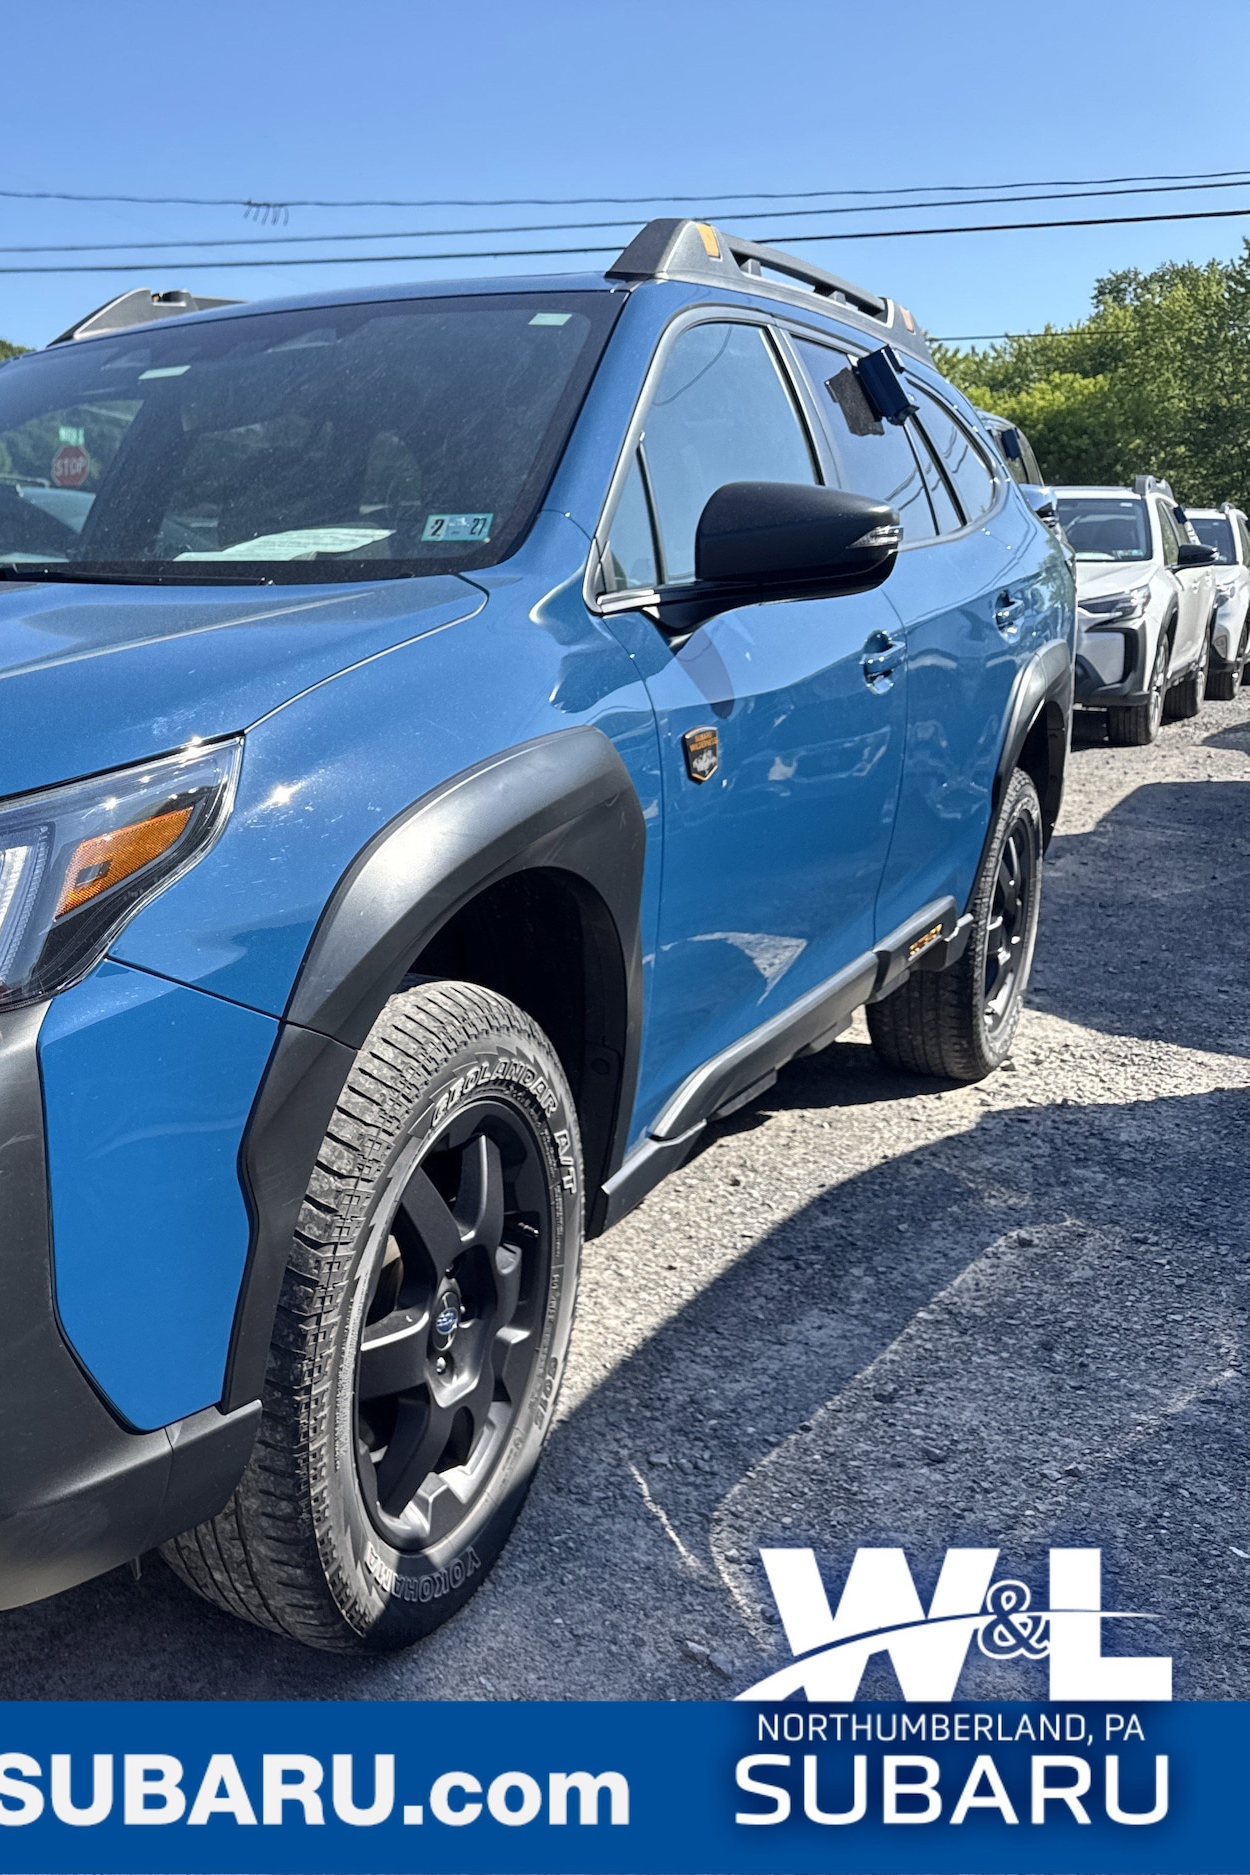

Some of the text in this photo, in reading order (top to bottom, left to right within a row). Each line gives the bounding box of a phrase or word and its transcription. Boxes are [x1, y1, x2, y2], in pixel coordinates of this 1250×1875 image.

[54, 456, 87, 477] STOP
[469, 517, 487, 536] 27
[431, 1056, 559, 1127] GEOLANDAR
[553, 1128, 577, 1194] A/T
[364, 1540, 482, 1603] YOKOHAMA
